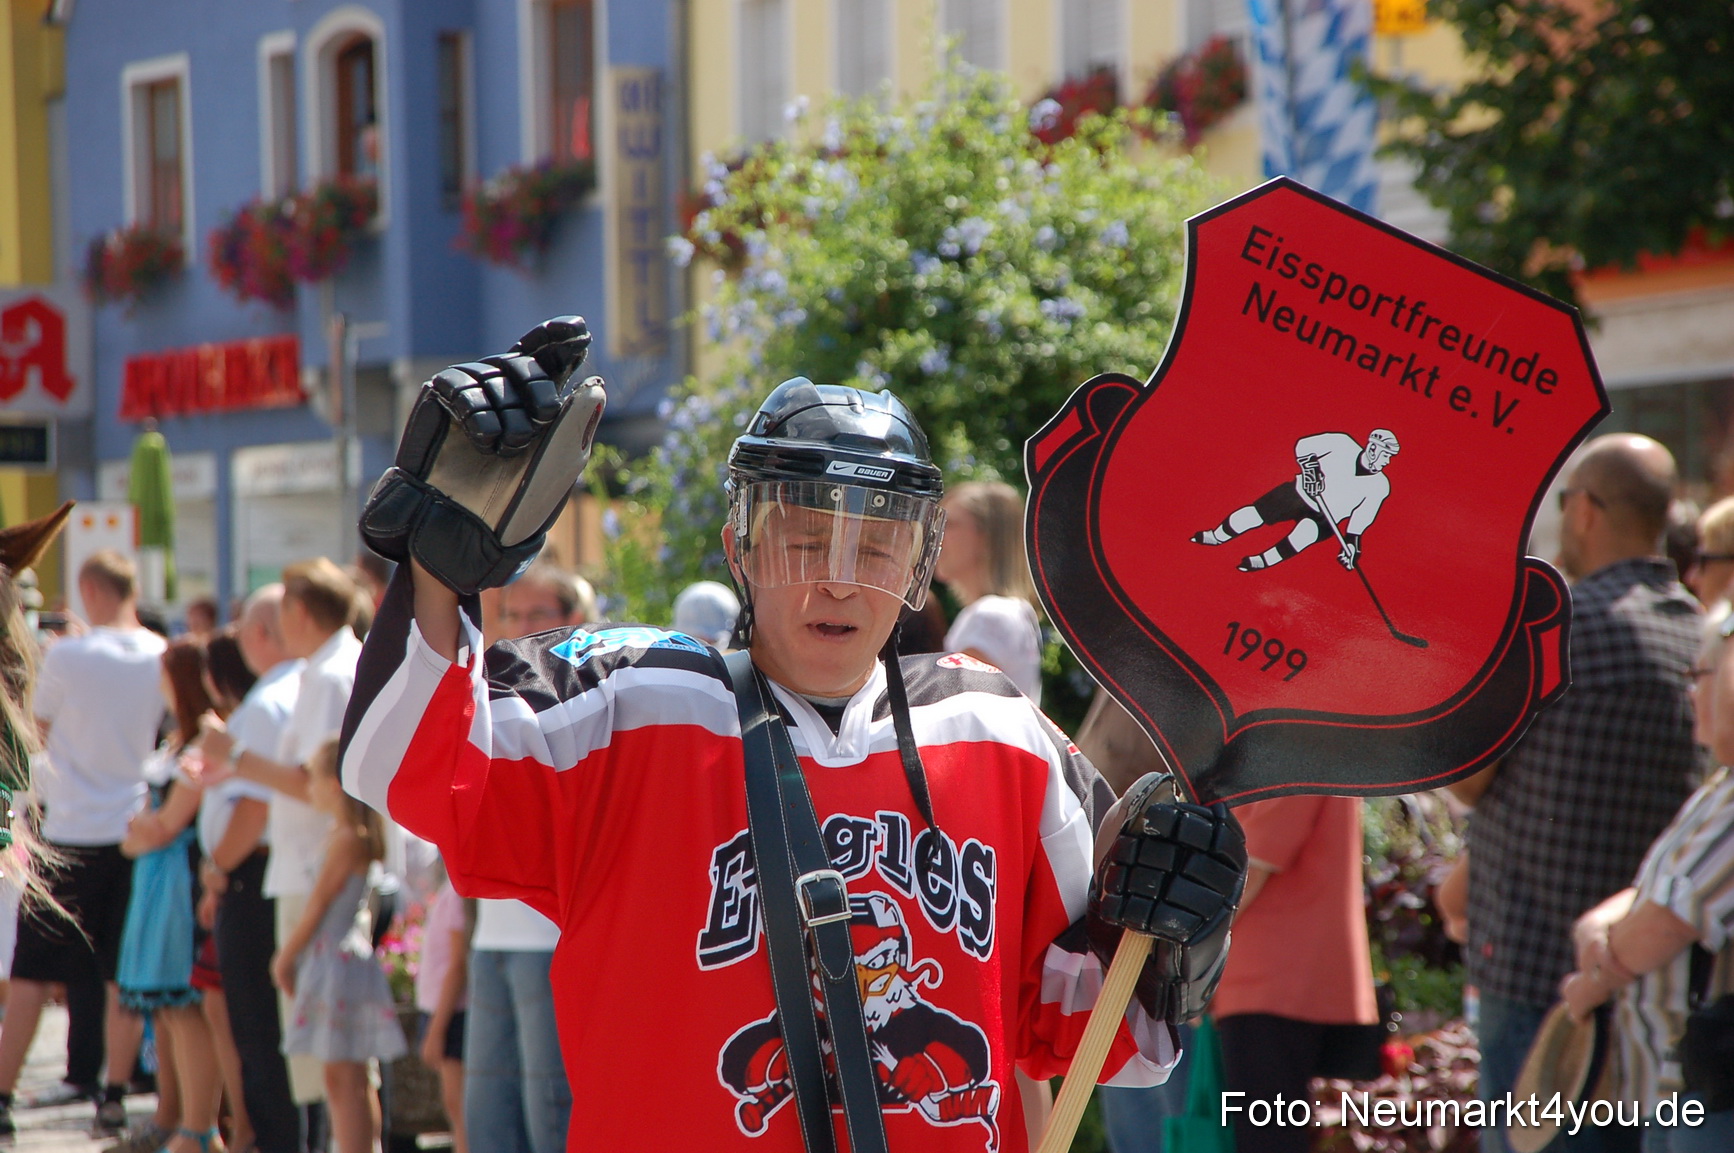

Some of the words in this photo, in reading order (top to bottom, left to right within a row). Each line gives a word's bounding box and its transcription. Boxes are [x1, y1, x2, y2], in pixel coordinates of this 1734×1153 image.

[1241, 224, 1559, 395] Eissportfreunde
[1241, 281, 1440, 399] Neumarkt
[1223, 621, 1308, 682] 1999
[696, 810, 998, 971] Egles
